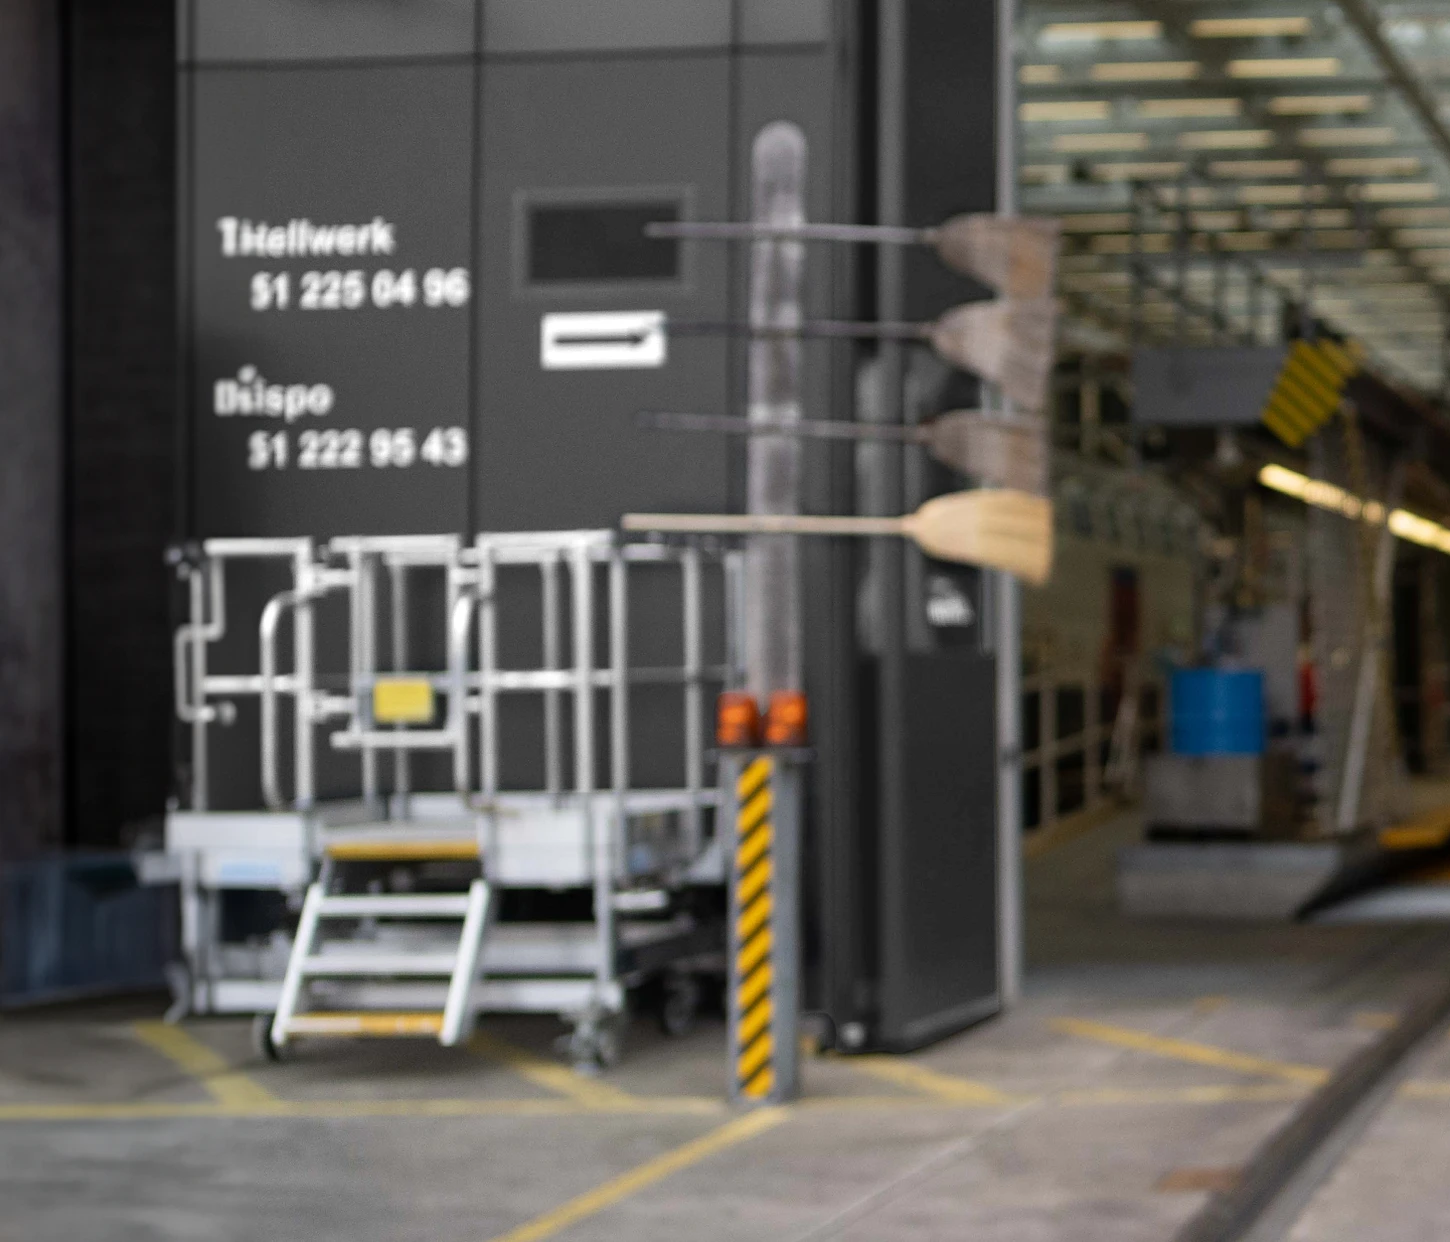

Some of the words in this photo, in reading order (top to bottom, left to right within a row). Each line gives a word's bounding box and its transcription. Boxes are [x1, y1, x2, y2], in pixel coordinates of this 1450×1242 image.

[251, 271, 290, 310] 51
[299, 269, 367, 310] 225
[370, 268, 418, 308] 04
[422, 266, 470, 307] 96
[249, 430, 288, 468] 51
[298, 428, 364, 468] 222
[369, 427, 417, 467] 95
[420, 426, 468, 467] 43
